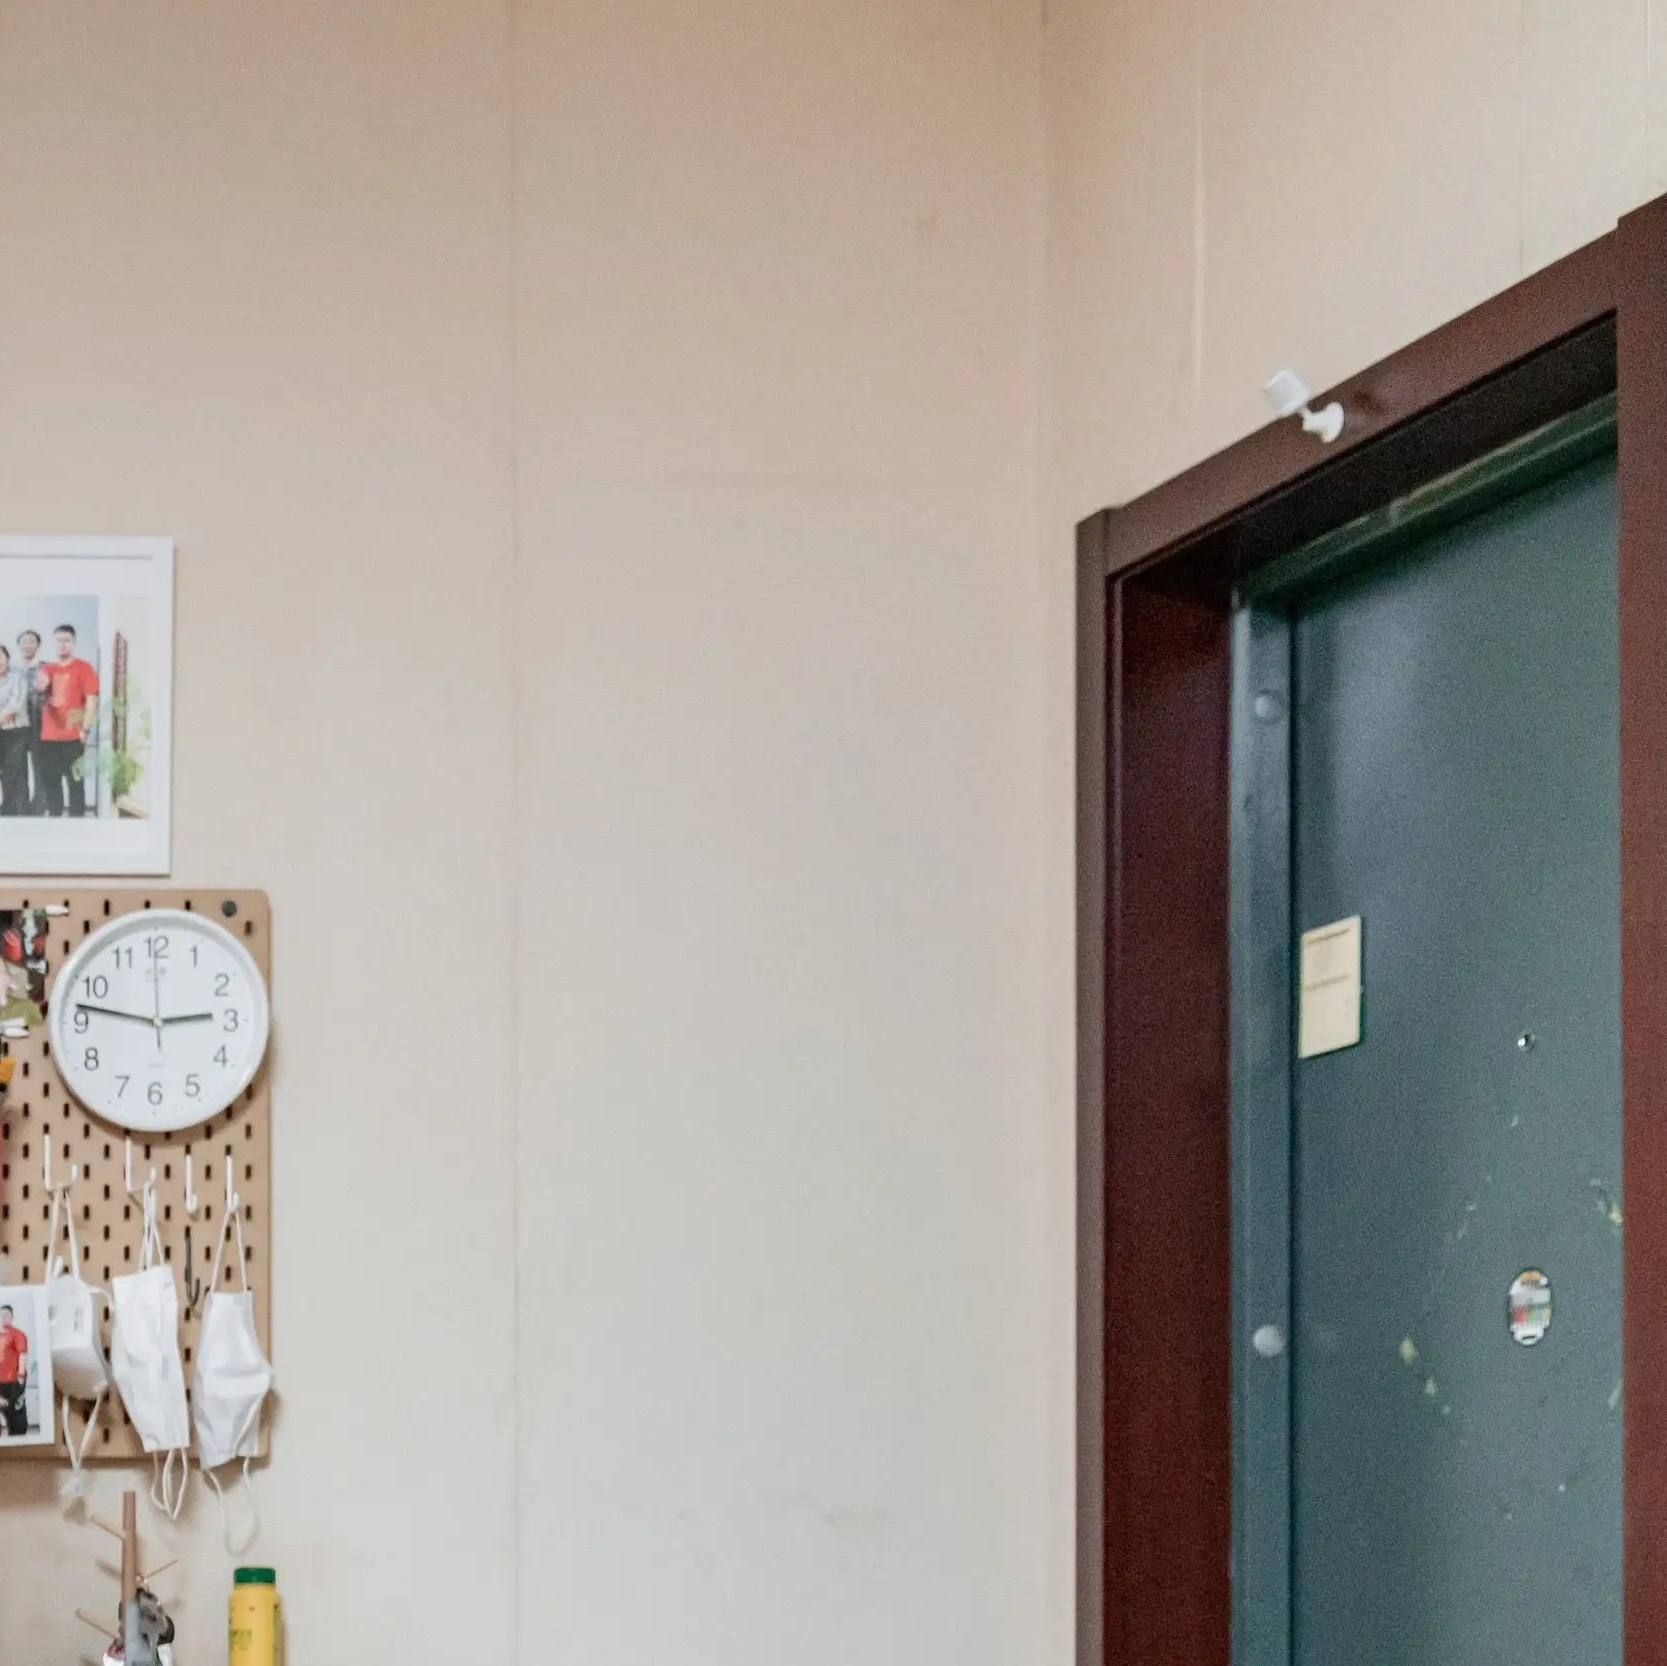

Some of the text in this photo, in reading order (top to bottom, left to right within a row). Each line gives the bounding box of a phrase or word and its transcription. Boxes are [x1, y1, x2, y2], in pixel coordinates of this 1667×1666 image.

[112, 947, 134, 970] 11
[144, 935, 171, 960] 12
[189, 946, 199, 967] 1
[82, 975, 109, 1000] 10
[214, 973, 230, 998] 2
[73, 1010, 90, 1035] 9
[222, 1008, 239, 1033] 3
[83, 1047, 100, 1071] 8
[212, 1045, 229, 1067] 4
[114, 1075, 130, 1099] 7
[147, 1081, 164, 1106] 6
[184, 1074, 201, 1098] 5
